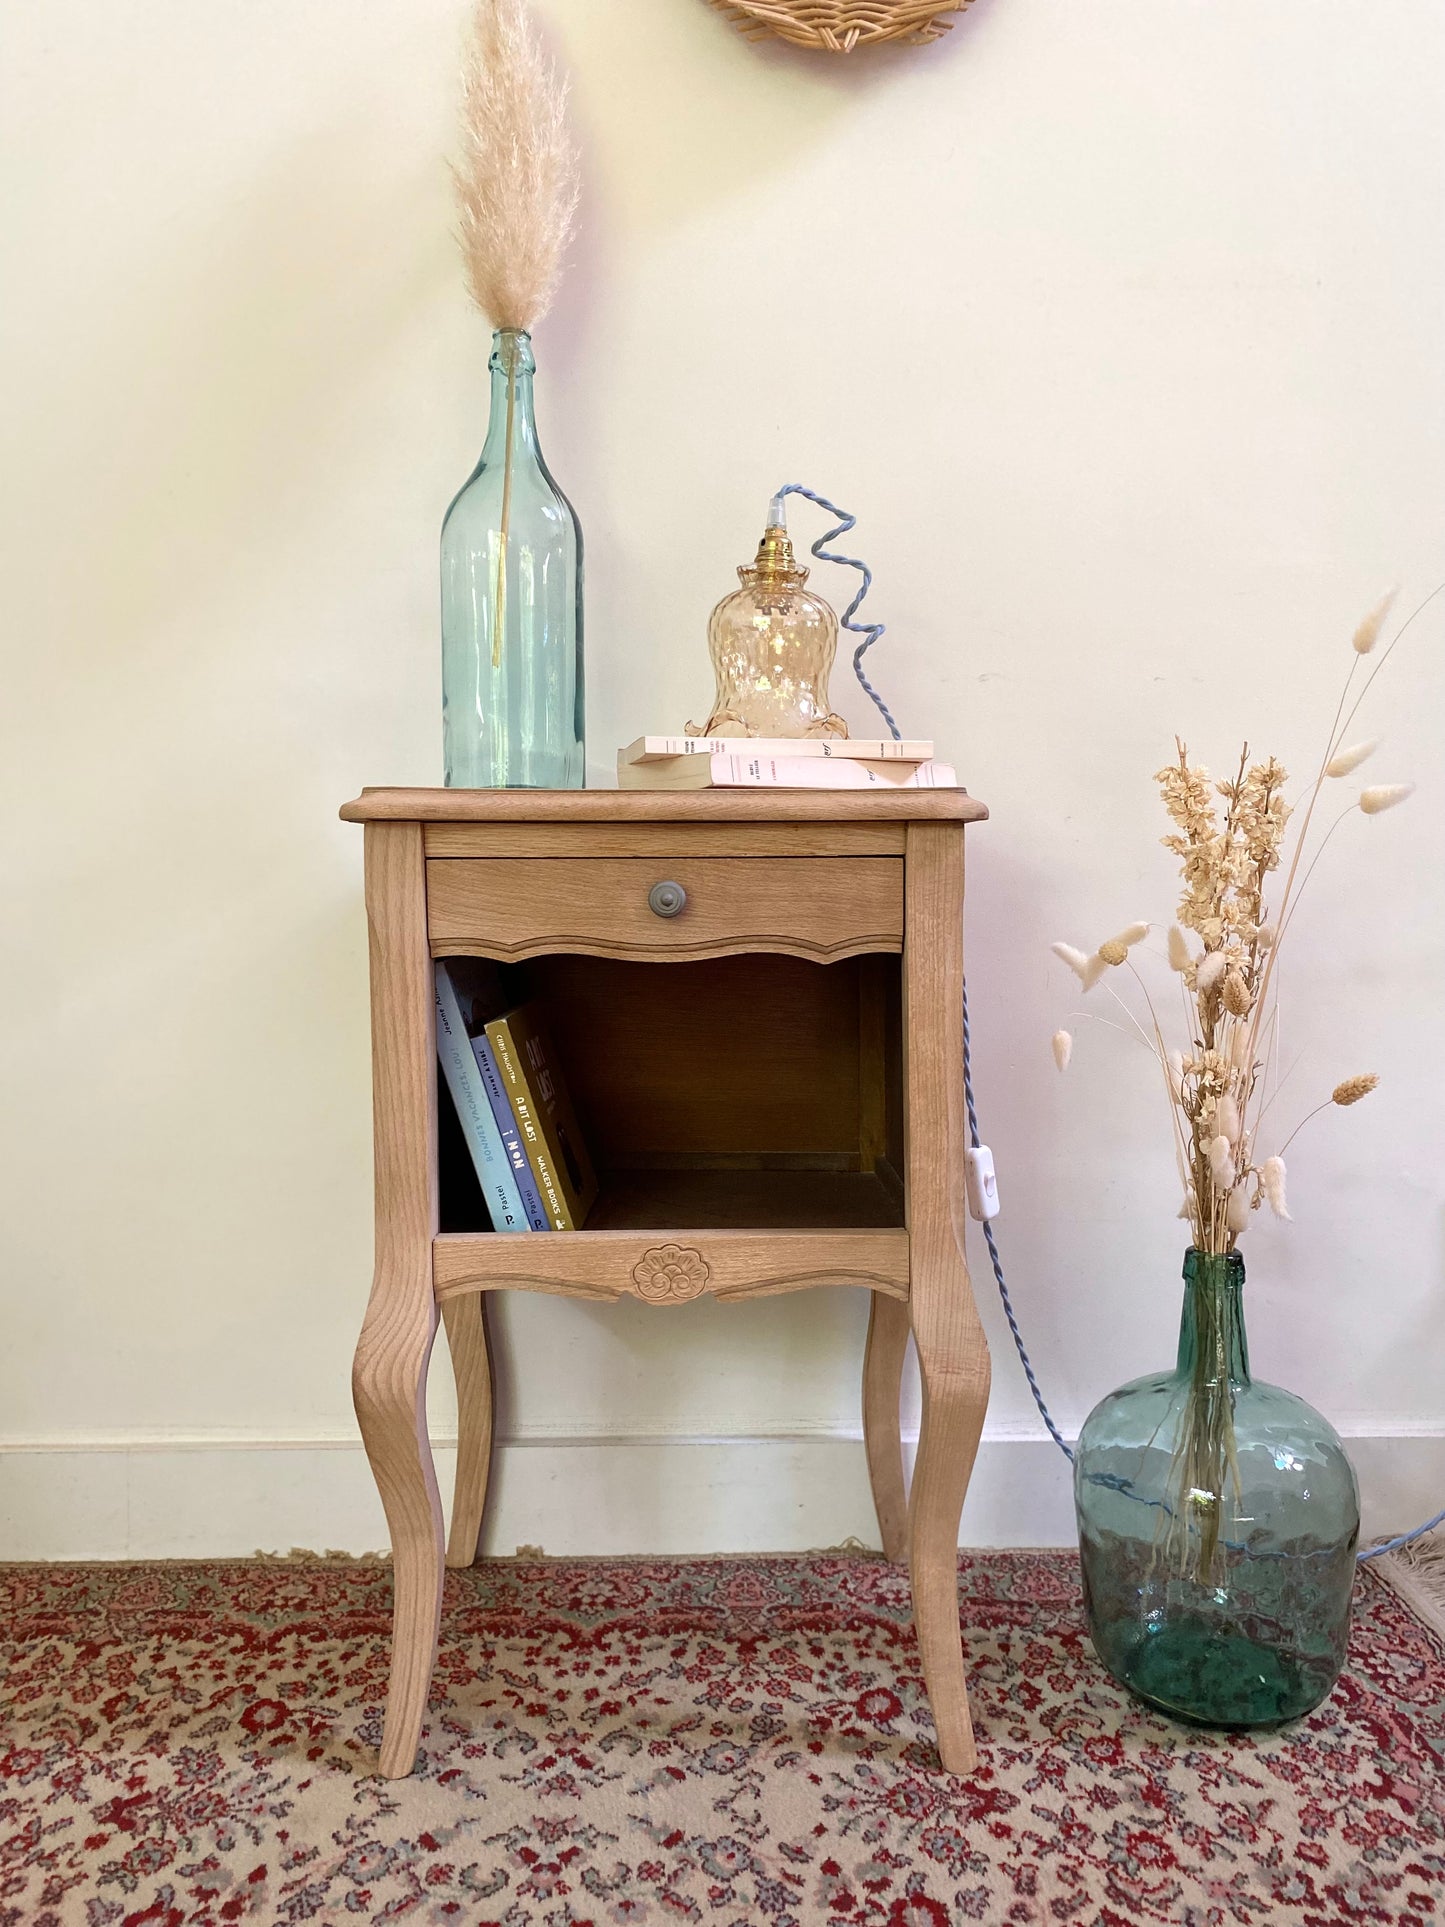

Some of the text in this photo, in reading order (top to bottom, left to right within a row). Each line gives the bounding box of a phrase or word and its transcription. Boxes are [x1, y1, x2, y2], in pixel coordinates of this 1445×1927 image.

[440, 1008, 452, 1036] Jeanne
[502, 1052, 516, 1084] HAUGHTON
[488, 1076, 500, 1098] JEANNE
[516, 1096, 536, 1142] A BIT LOST
[476, 1125, 494, 1162] BONNES
[508, 1141, 525, 1169] NON
[496, 1185, 509, 1210] Pastel
[537, 1156, 560, 1214] WALKER BOOKS
[524, 1190, 538, 1214] Pastel
